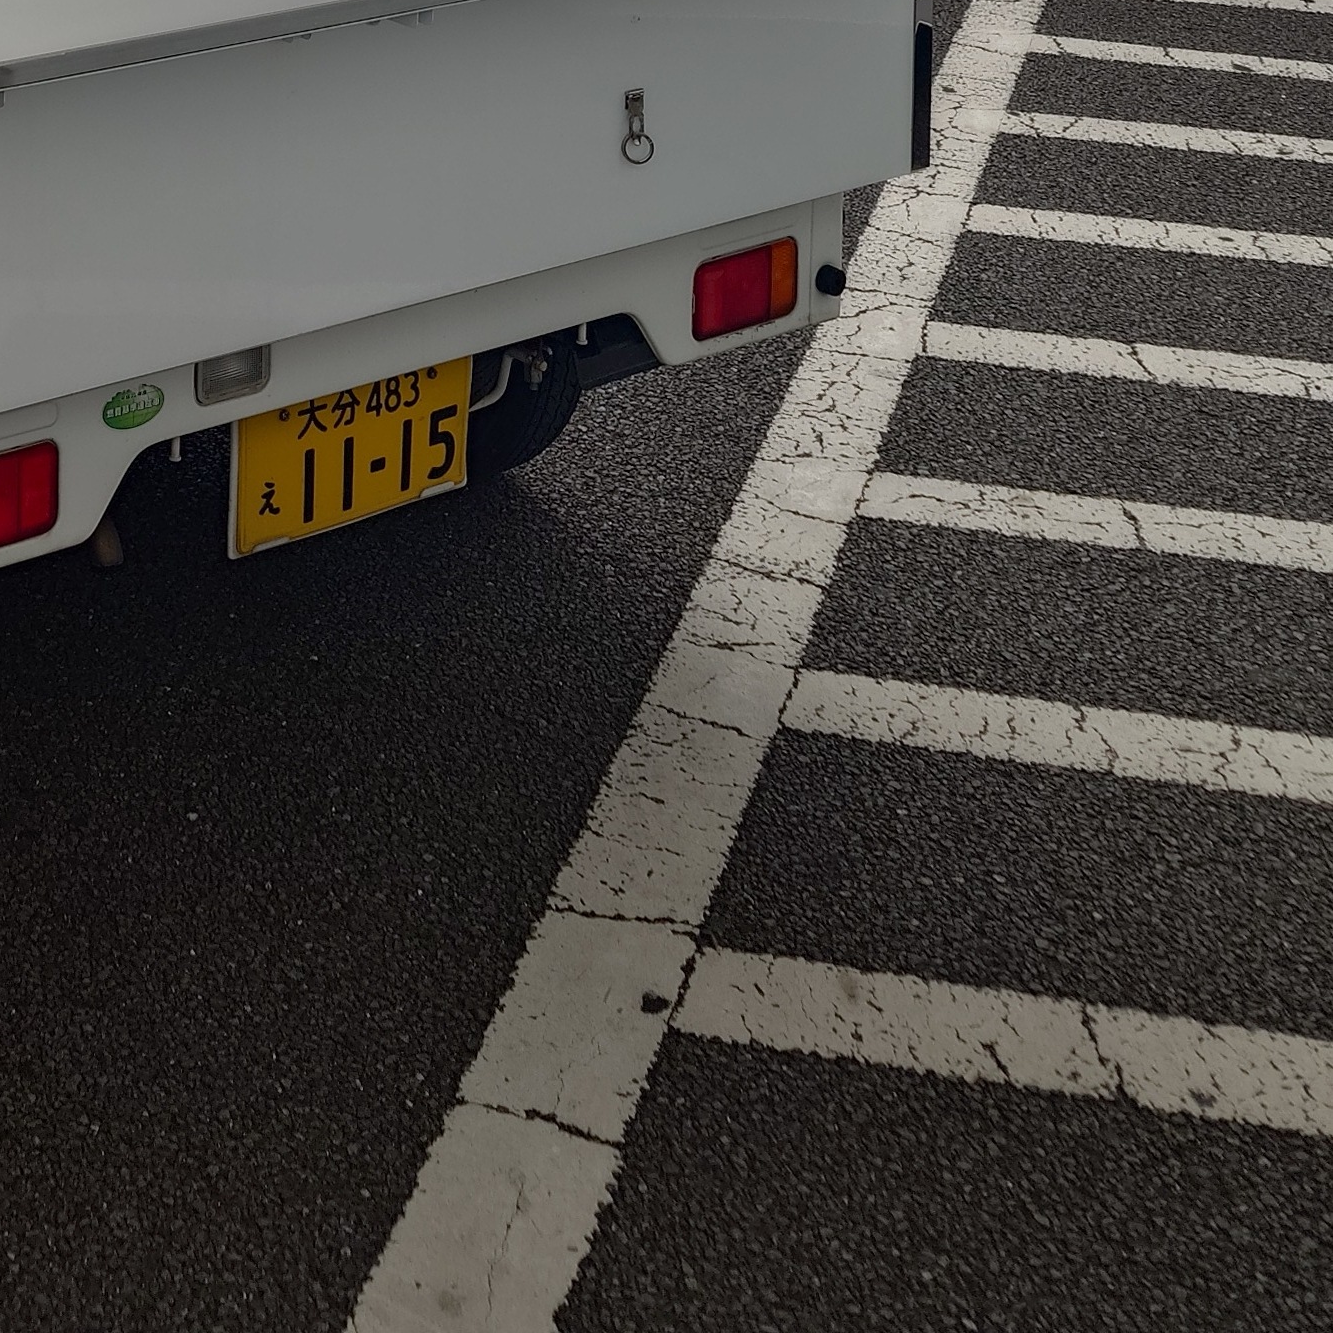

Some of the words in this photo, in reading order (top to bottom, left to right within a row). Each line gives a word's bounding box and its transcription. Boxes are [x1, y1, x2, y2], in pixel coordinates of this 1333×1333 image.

[297, 388, 361, 440] 大分
[364, 371, 421, 418] 483
[258, 482, 281, 516] え
[302, 404, 459, 524] 11-15
